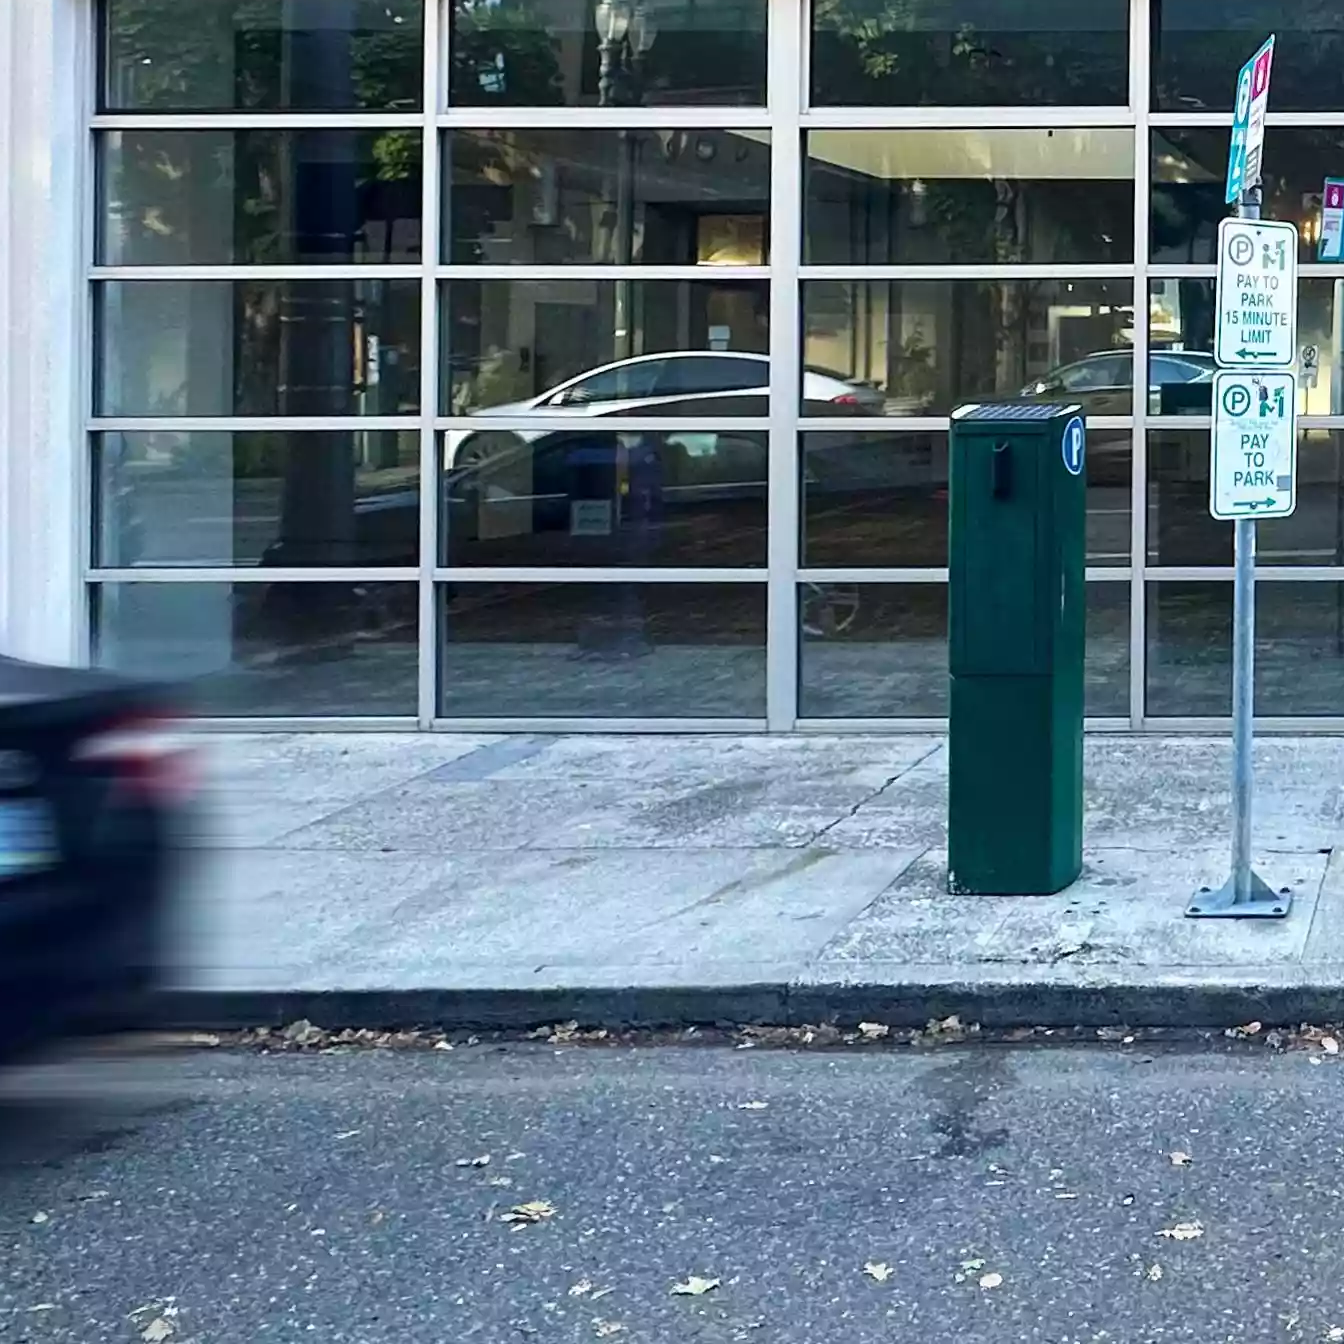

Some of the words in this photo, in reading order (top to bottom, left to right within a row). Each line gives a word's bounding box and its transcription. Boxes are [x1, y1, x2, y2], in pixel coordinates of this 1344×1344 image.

[1236, 240, 1249, 260] P
[1236, 273, 1260, 288] PAY
[1263, 275, 1279, 290] TO
[1241, 292, 1273, 307] PARK
[1225, 310, 1239, 325] 15
[1242, 311, 1288, 326] MINUTE
[1240, 329, 1272, 344] LIMIT
[1231, 391, 1245, 410] P
[1240, 434, 1269, 450] PAY
[1244, 452, 1265, 468] TO
[1234, 470, 1275, 487] PARK
